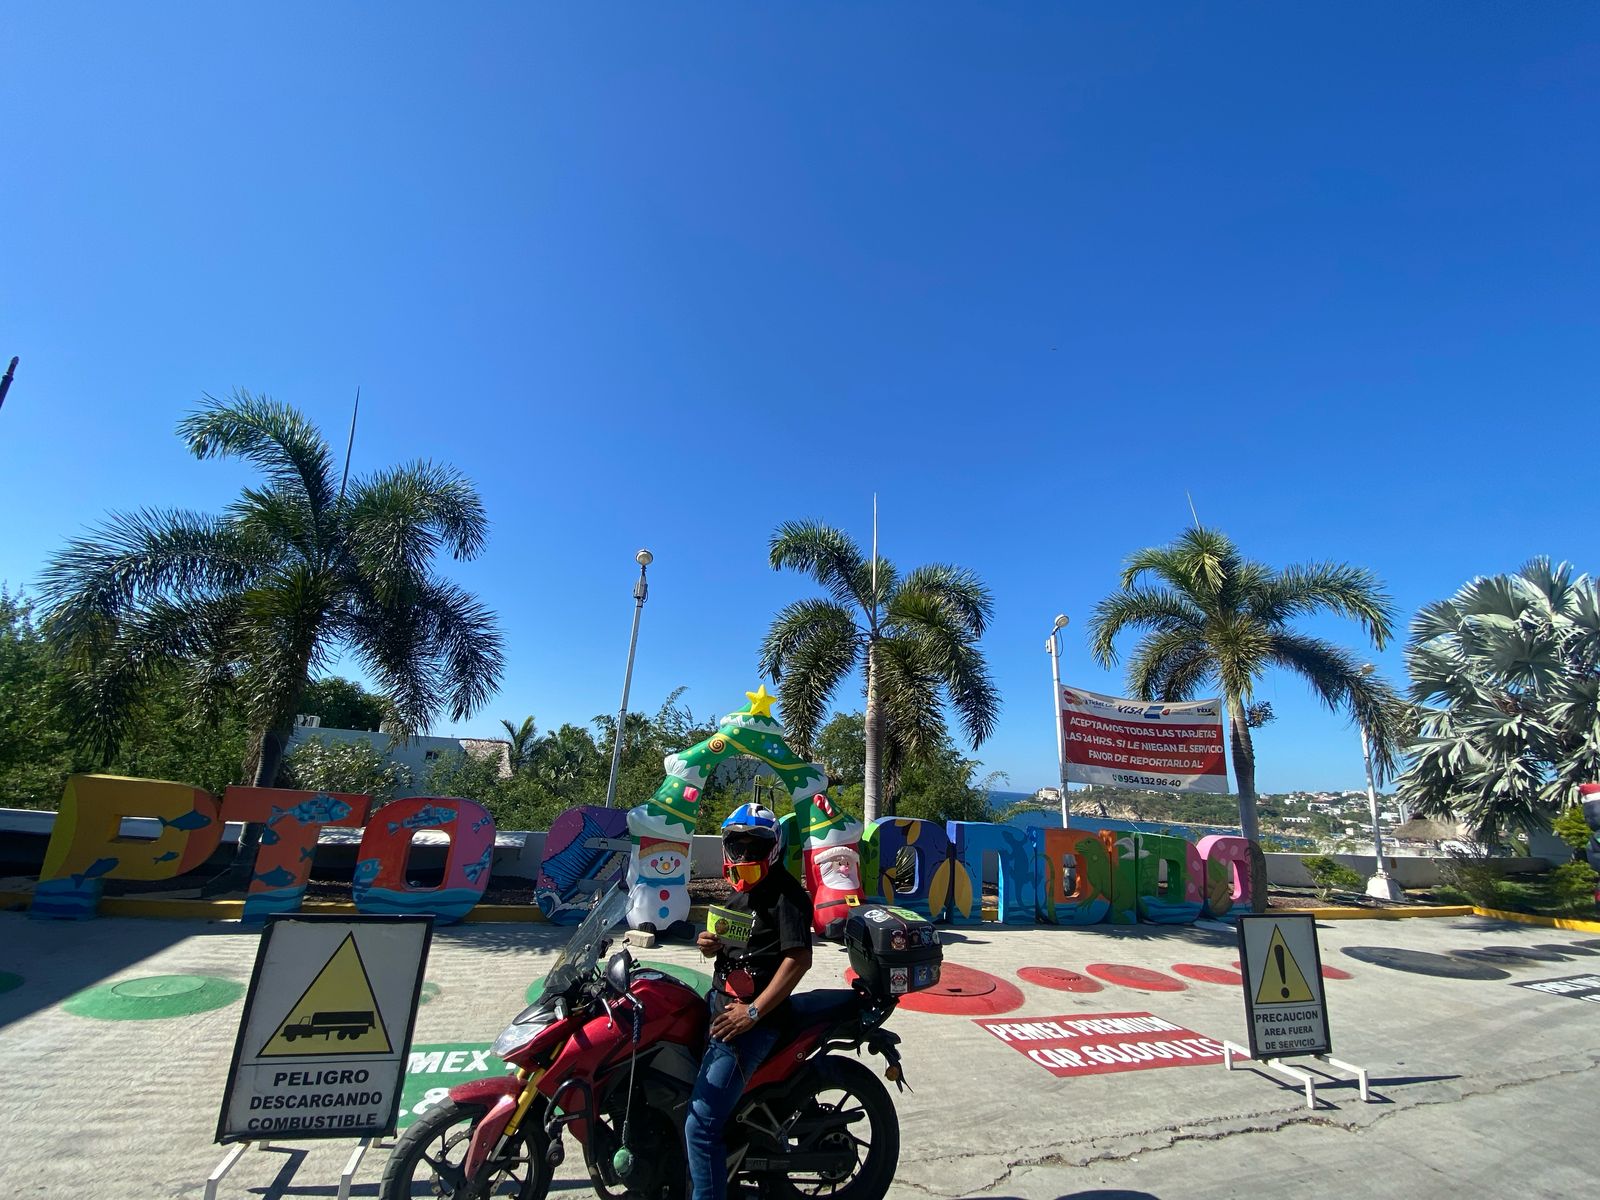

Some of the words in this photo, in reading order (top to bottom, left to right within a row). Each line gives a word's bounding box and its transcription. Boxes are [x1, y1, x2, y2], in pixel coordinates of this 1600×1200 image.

[1117, 705, 1144, 715] VISA
[1070, 716, 1125, 734] ACEPTAMOS
[1124, 726, 1155, 737] TODAS
[1156, 729, 1175, 738] LAS
[1175, 730, 1217, 738] TARJETAS
[1065, 731, 1082, 741] LAS
[1082, 733, 1093, 743] 24
[1093, 736, 1115, 747] HRS.
[1116, 740, 1126, 748] SI
[1127, 741, 1140, 750] LE
[1141, 742, 1177, 752] NIEGAN
[1178, 744, 1189, 753] EL
[1189, 744, 1224, 753] SERVICIO
[1088, 749, 1114, 761] FAVOR
[1114, 753, 1129, 763] DE
[1130, 755, 1190, 768] REPORTARLO
[1191, 759, 1204, 768] AL:
[1123, 775, 1140, 784] 954
[1140, 777, 1155, 786] 132
[1156, 778, 1168, 786] 96
[1168, 779, 1181, 788] 40
[28, 773, 496, 927] PTO
[1255, 1010, 1319, 1023] PRECAUCION
[985, 1021, 1079, 1041] PEMEX
[1064, 1016, 1183, 1036] PREMIUM
[1264, 1027, 1287, 1036] AREA
[1288, 1025, 1313, 1035] FUERA
[1265, 1041, 1276, 1050] DE
[1278, 1038, 1316, 1049] SERVICIO
[406, 1050, 491, 1073] MEX
[273, 1069, 369, 1087] PELIGRO
[250, 1091, 382, 1110] DESCARGANDO
[247, 1112, 377, 1130] COMBUSTIBLE
